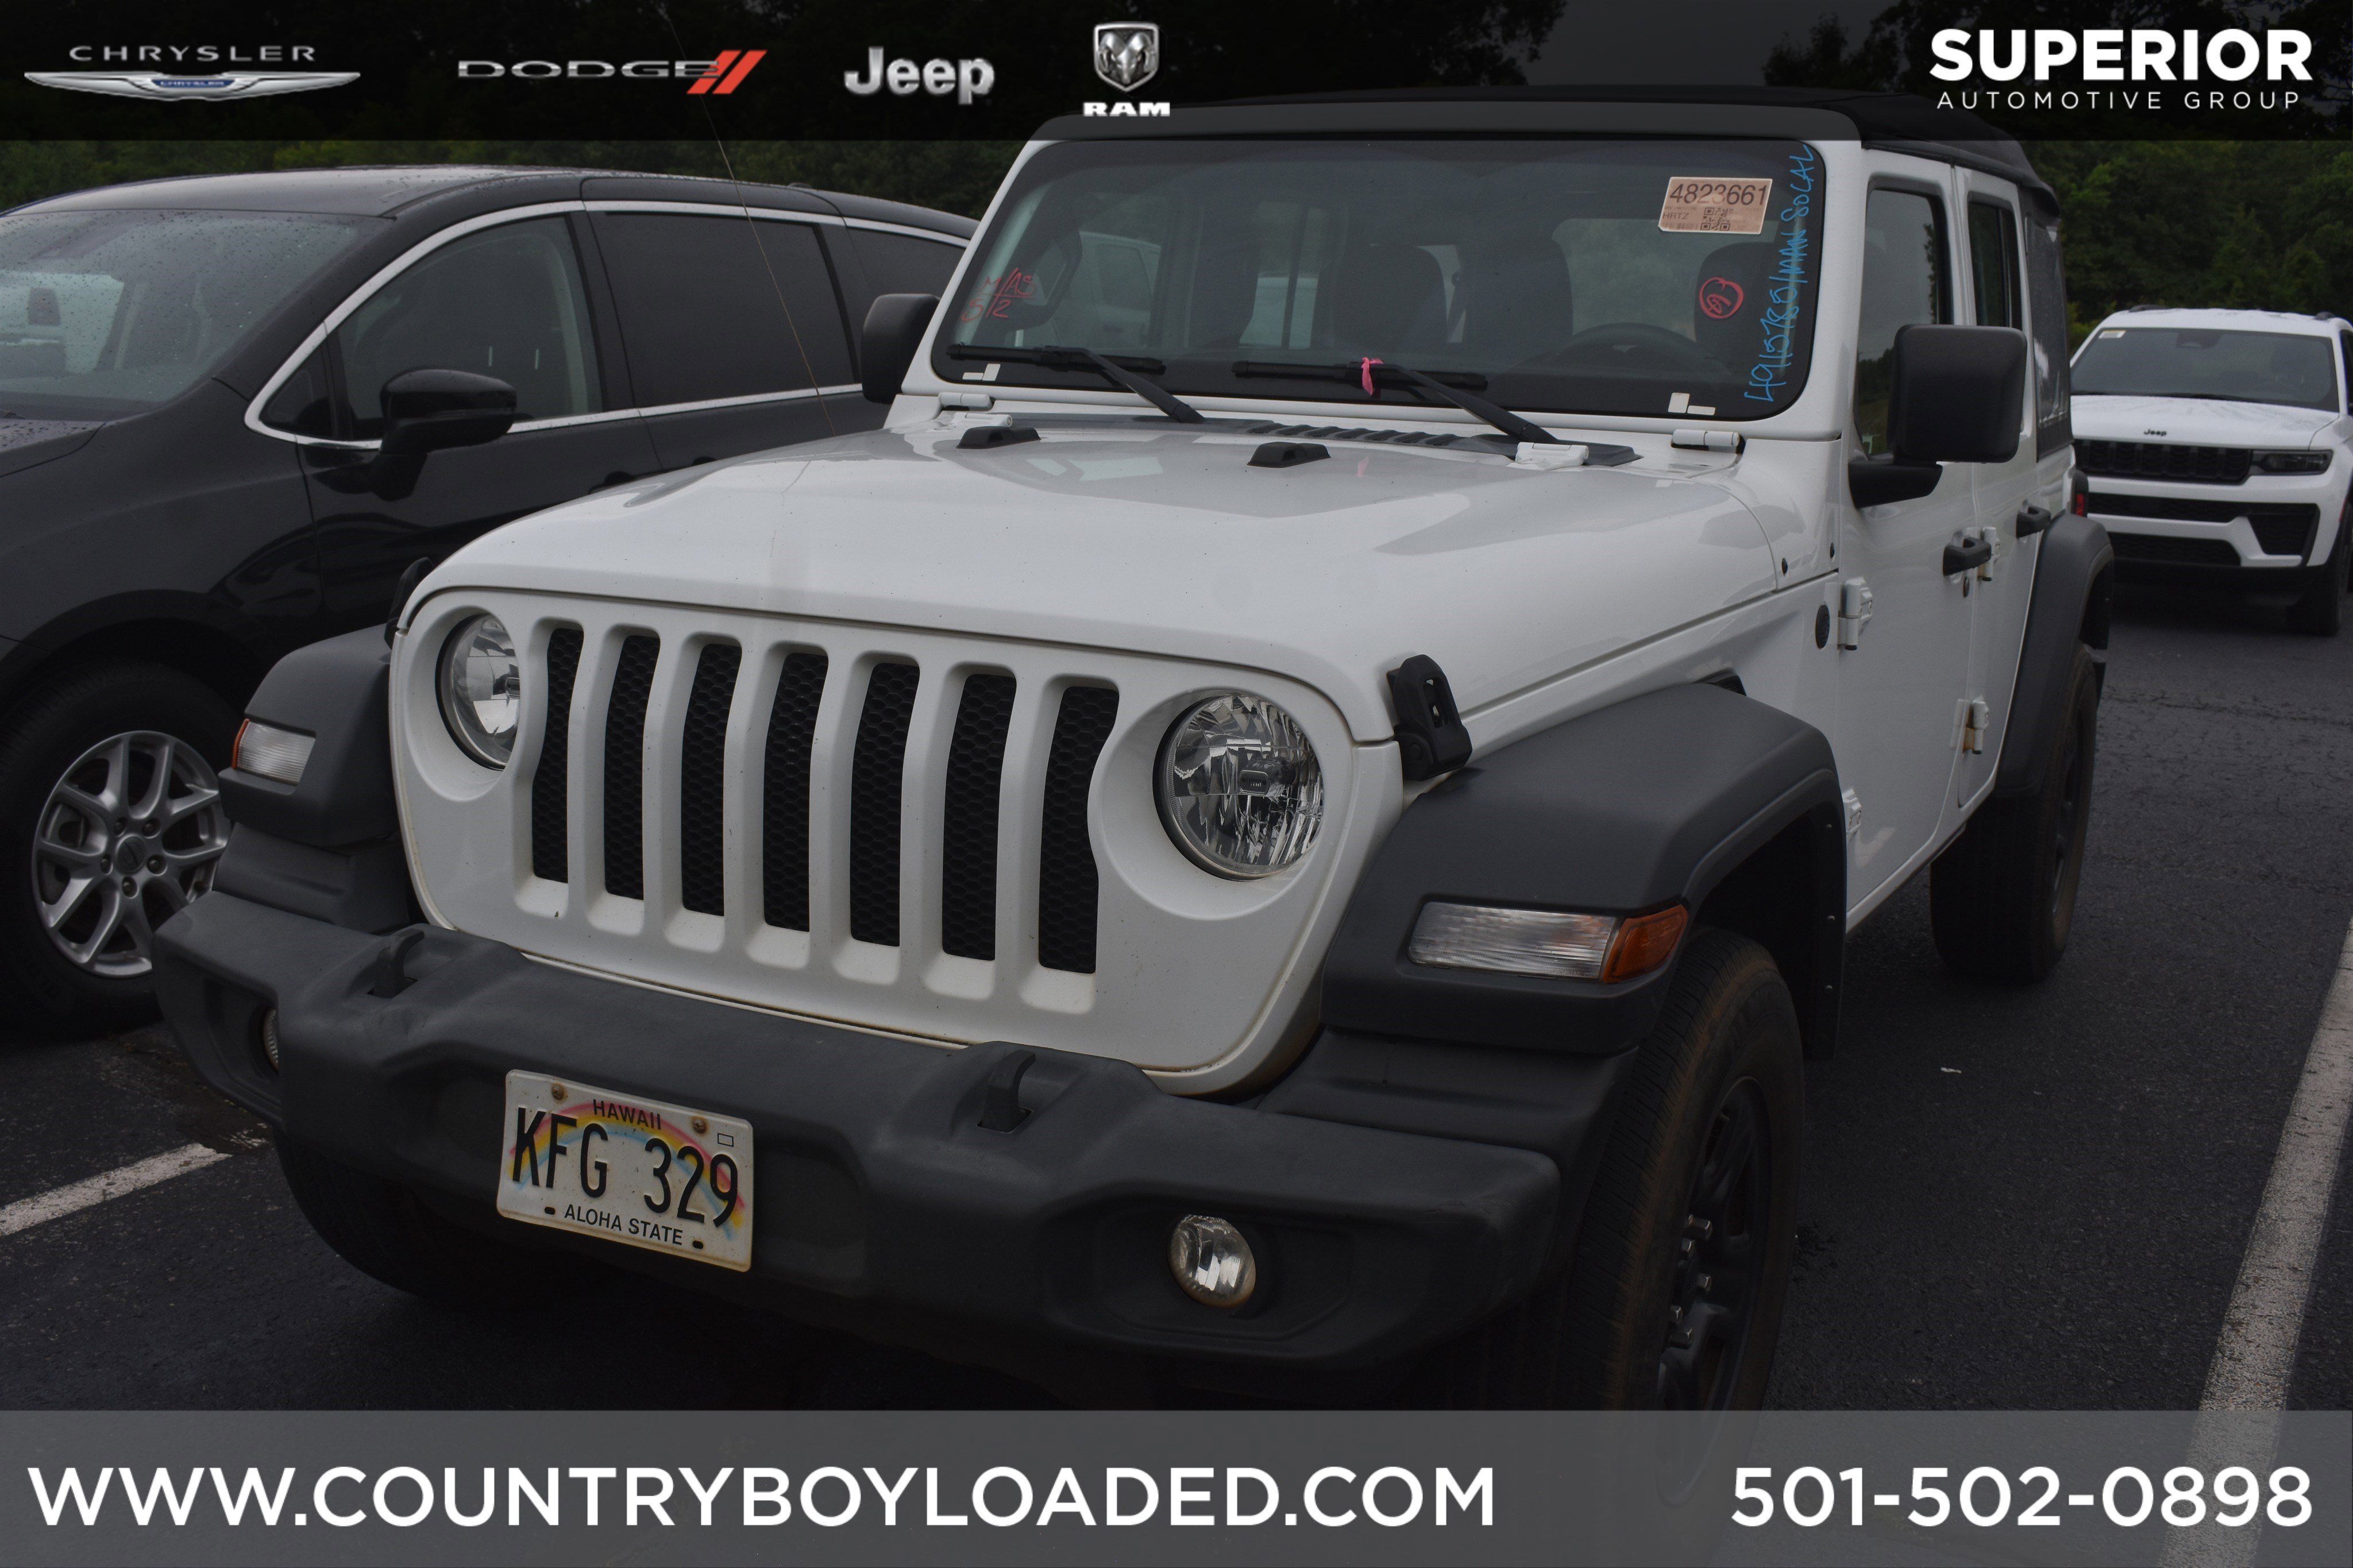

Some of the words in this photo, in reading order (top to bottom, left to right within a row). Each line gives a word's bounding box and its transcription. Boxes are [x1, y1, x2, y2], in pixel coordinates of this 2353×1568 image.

[1670, 183, 1767, 206] 4823661
[2144, 428, 2167, 437] Jeep
[593, 1099, 662, 1130] HAWAII
[512, 1107, 608, 1198] KFG
[644, 1138, 738, 1227] 329
[564, 1204, 622, 1231] ALOHA
[628, 1218, 683, 1245] STATE
